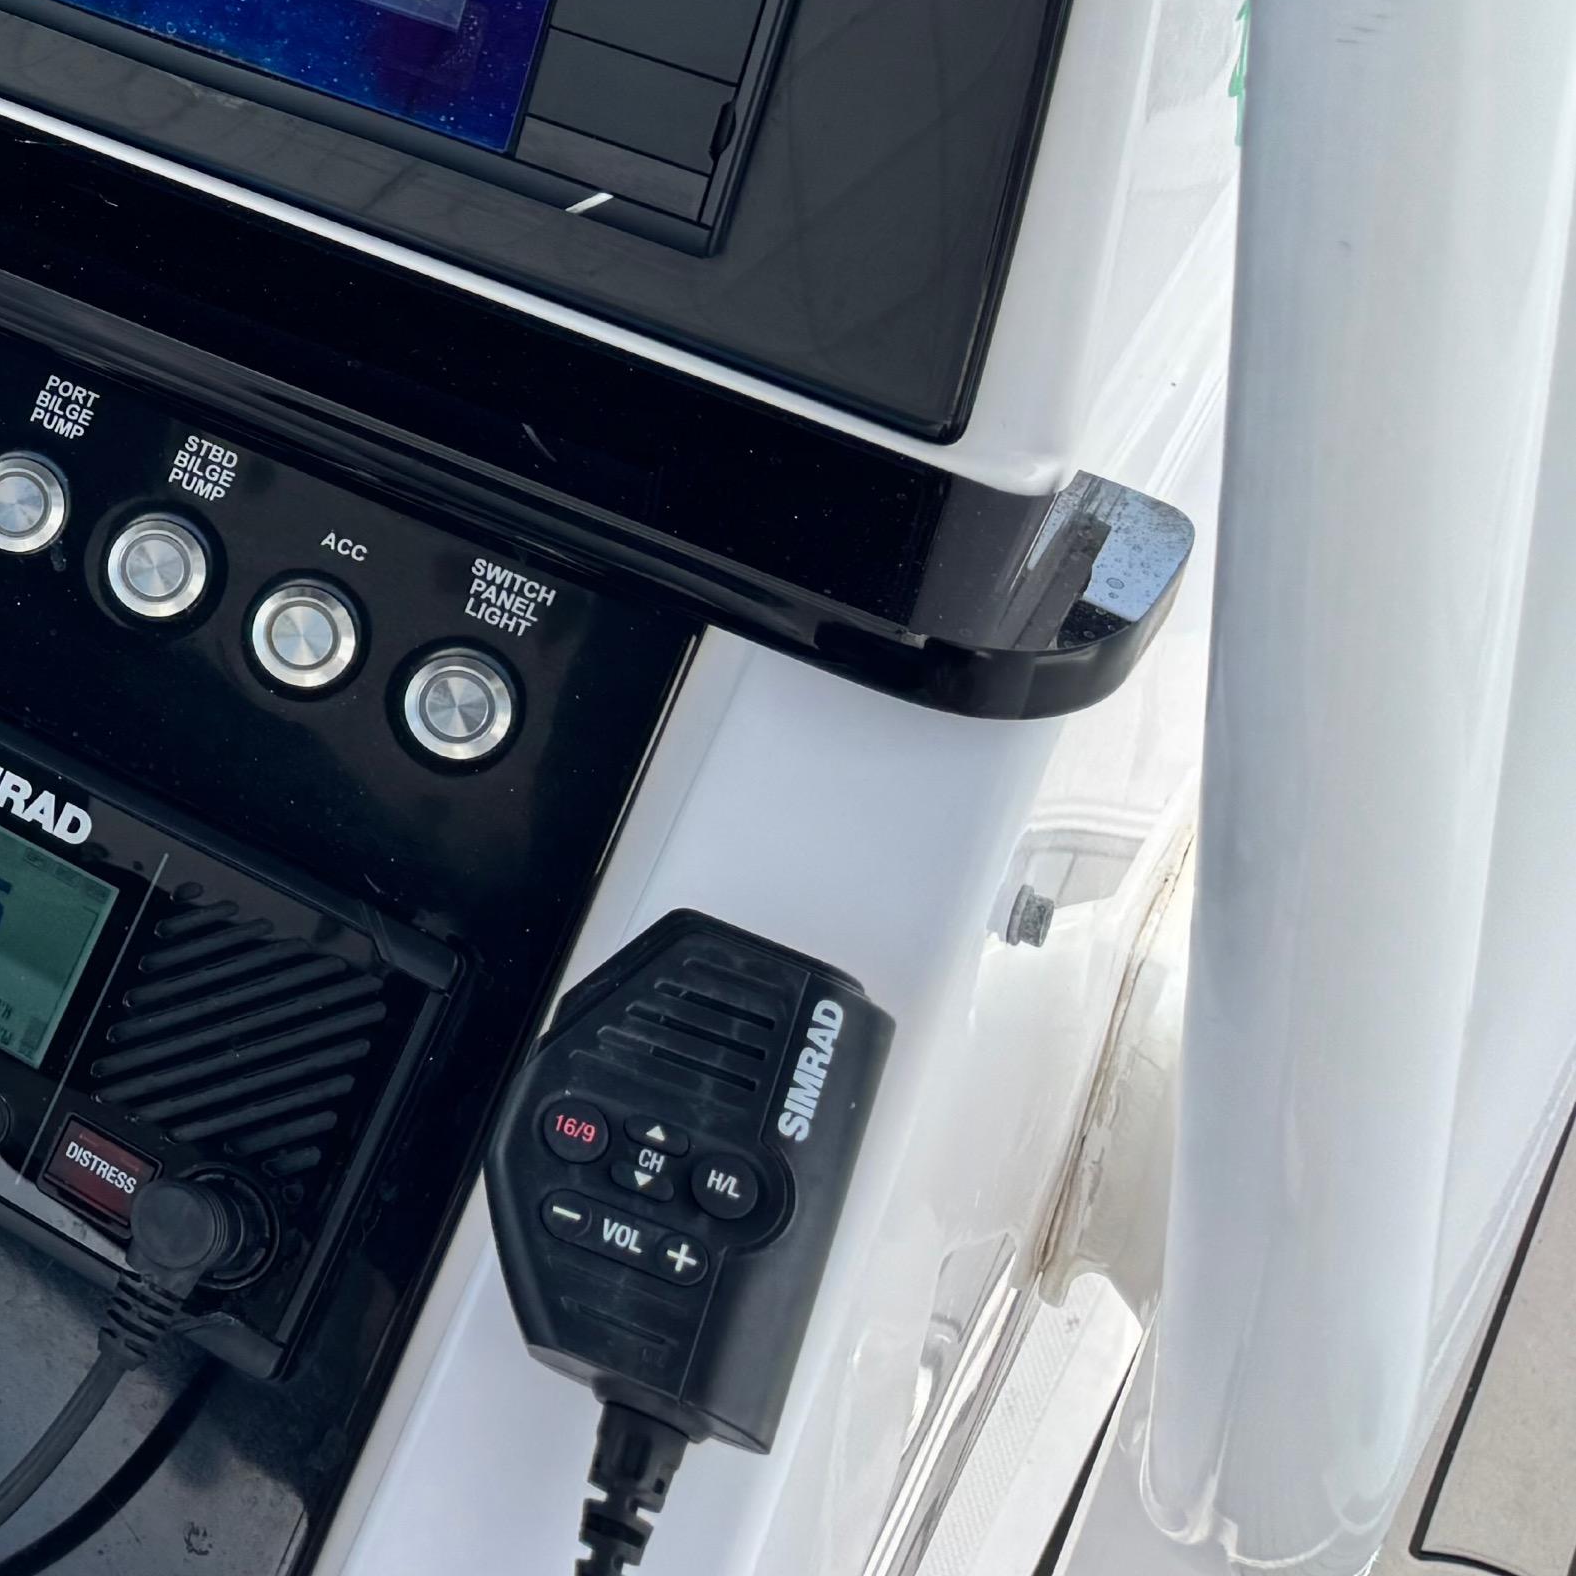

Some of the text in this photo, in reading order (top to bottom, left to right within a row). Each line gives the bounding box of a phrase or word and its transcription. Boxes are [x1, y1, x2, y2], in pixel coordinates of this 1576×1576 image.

[35, 389, 94, 427] BILGE
[46, 375, 100, 409] PORT
[30, 407, 85, 440] PUMP
[173, 449, 236, 488] BILGE
[184, 435, 238, 470] STBD
[168, 468, 225, 502] PUMP
[320, 532, 368, 562] ACC
[469, 579, 539, 622] PANEL
[471, 558, 556, 607] SWITCH
[464, 597, 532, 637] LIGHT
[777, 998, 844, 1142] SIMRAD
[553, 1113, 597, 1144] 16/9
[65, 1141, 137, 1194] DISTRESS
[638, 1147, 665, 1174] CH
[707, 1169, 741, 1199] H/L
[602, 1218, 643, 1255] VOL
